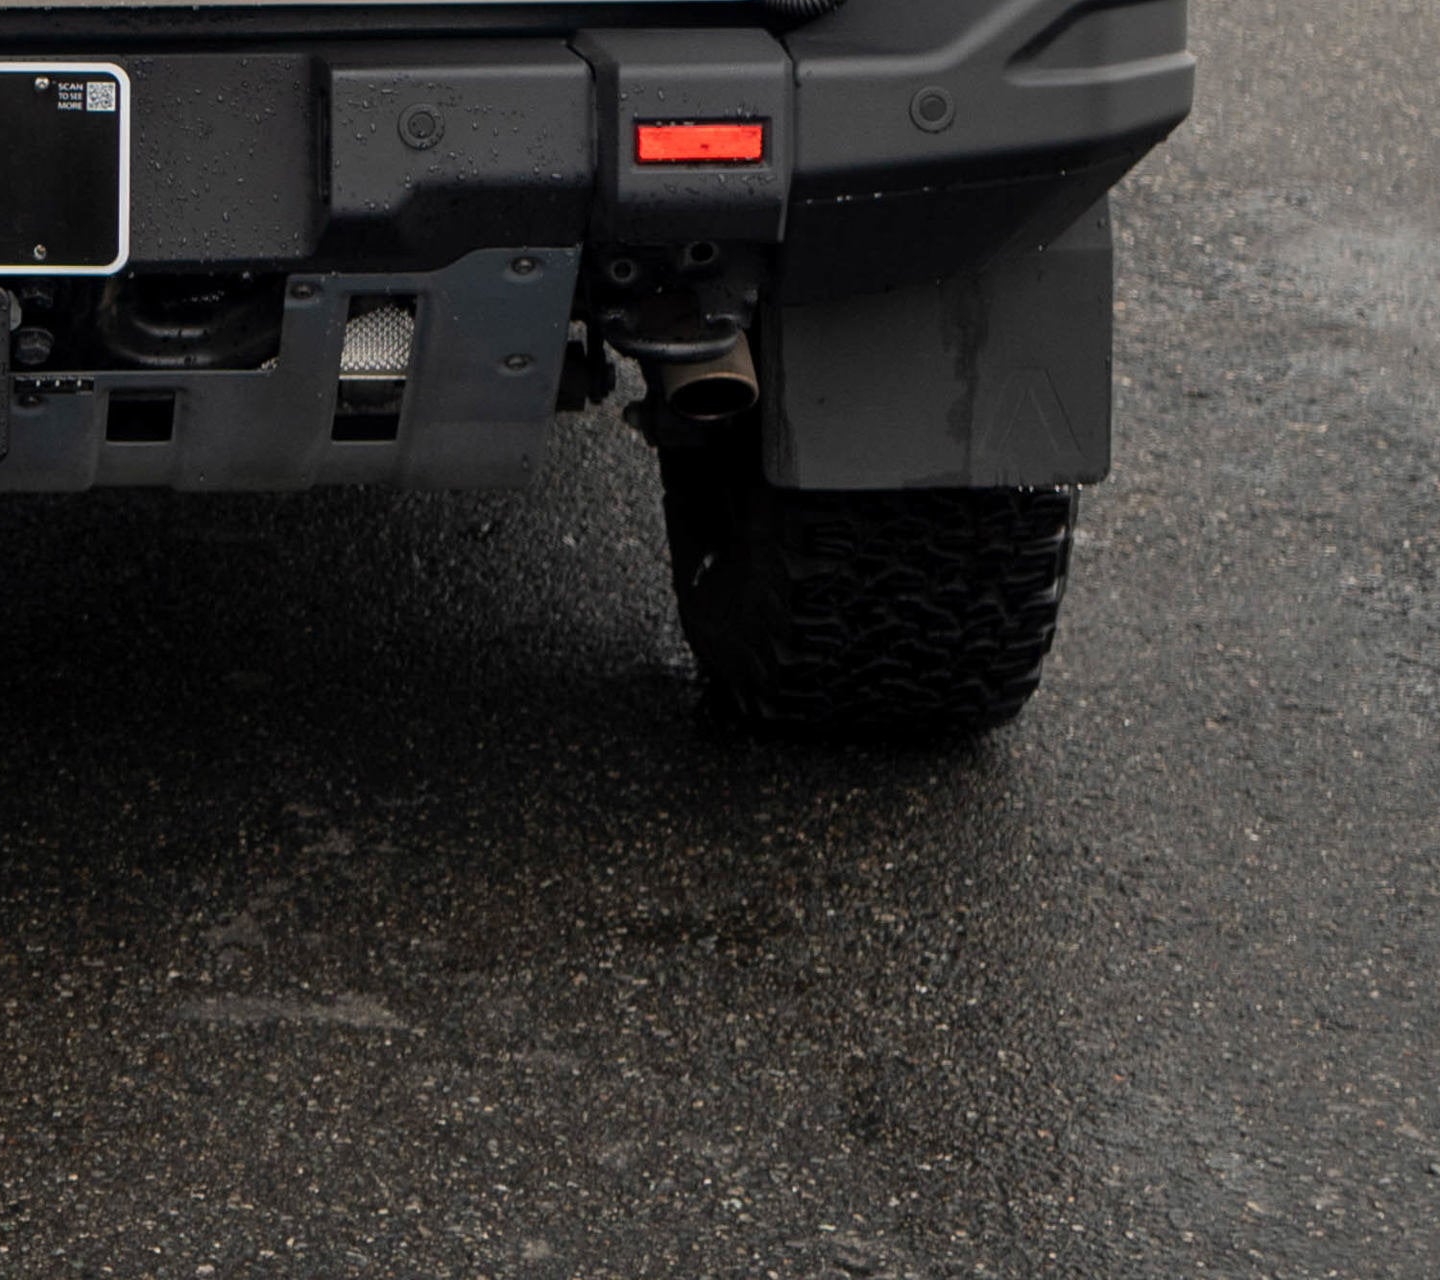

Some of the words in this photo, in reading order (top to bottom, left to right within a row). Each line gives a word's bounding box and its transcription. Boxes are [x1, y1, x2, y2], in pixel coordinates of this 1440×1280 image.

[57, 82, 84, 91] SCAN
[58, 92, 69, 100] TO
[70, 92, 83, 100] SEE
[57, 101, 83, 110] MORE
